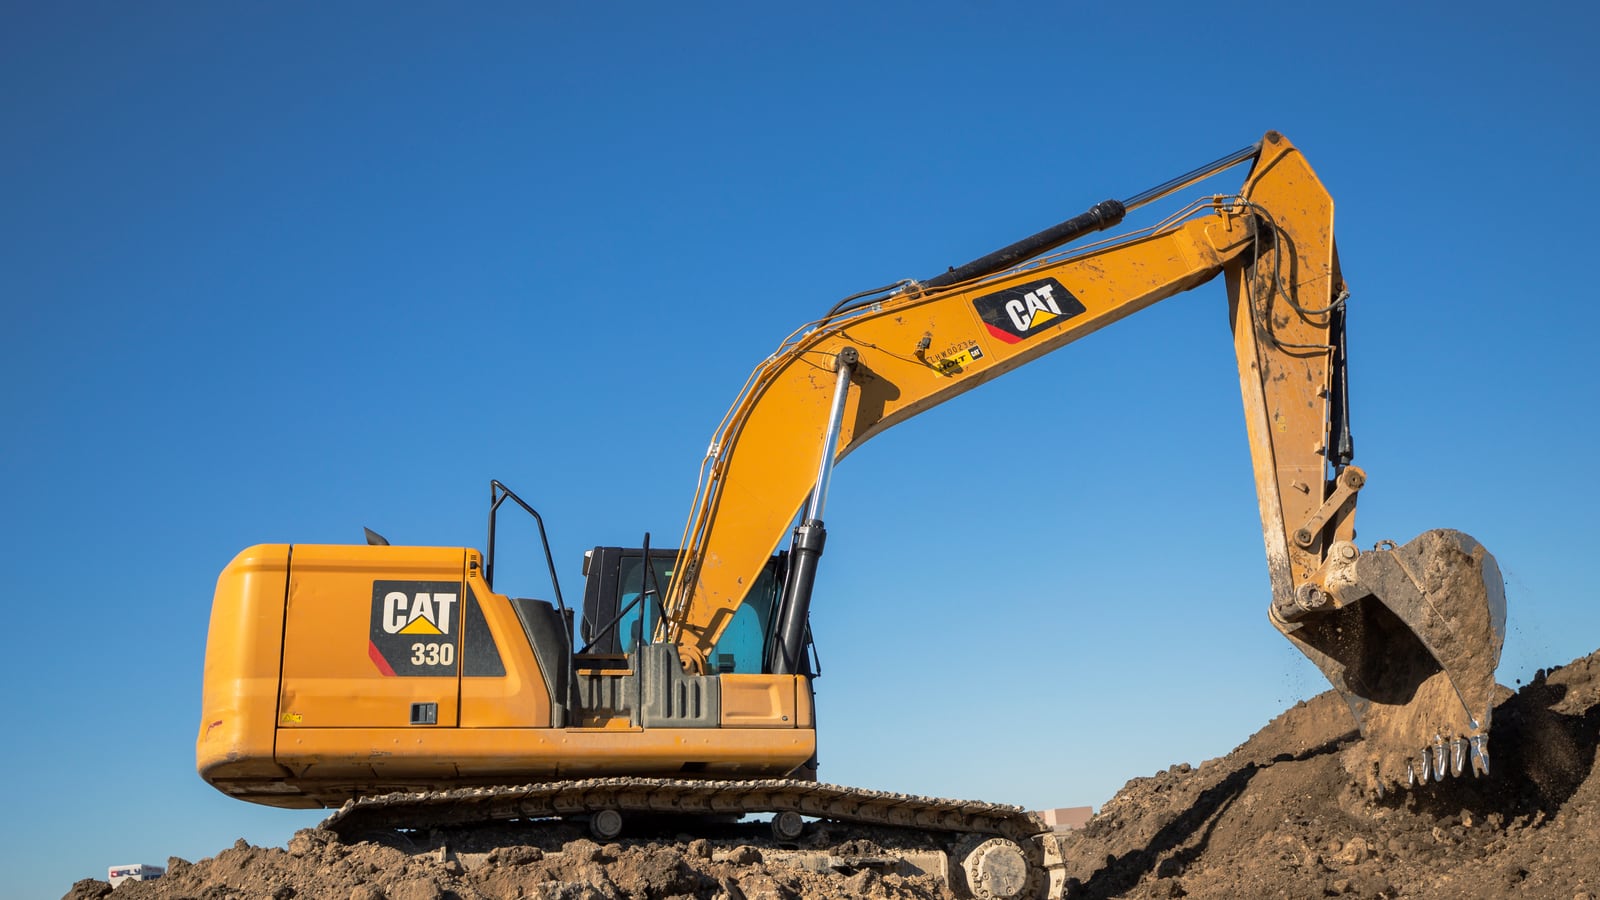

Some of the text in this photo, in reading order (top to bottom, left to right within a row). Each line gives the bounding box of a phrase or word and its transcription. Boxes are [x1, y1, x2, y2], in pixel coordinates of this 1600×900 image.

[1005, 284, 1062, 332] CAT
[382, 591, 457, 635] CAT
[411, 642, 454, 666] 330
